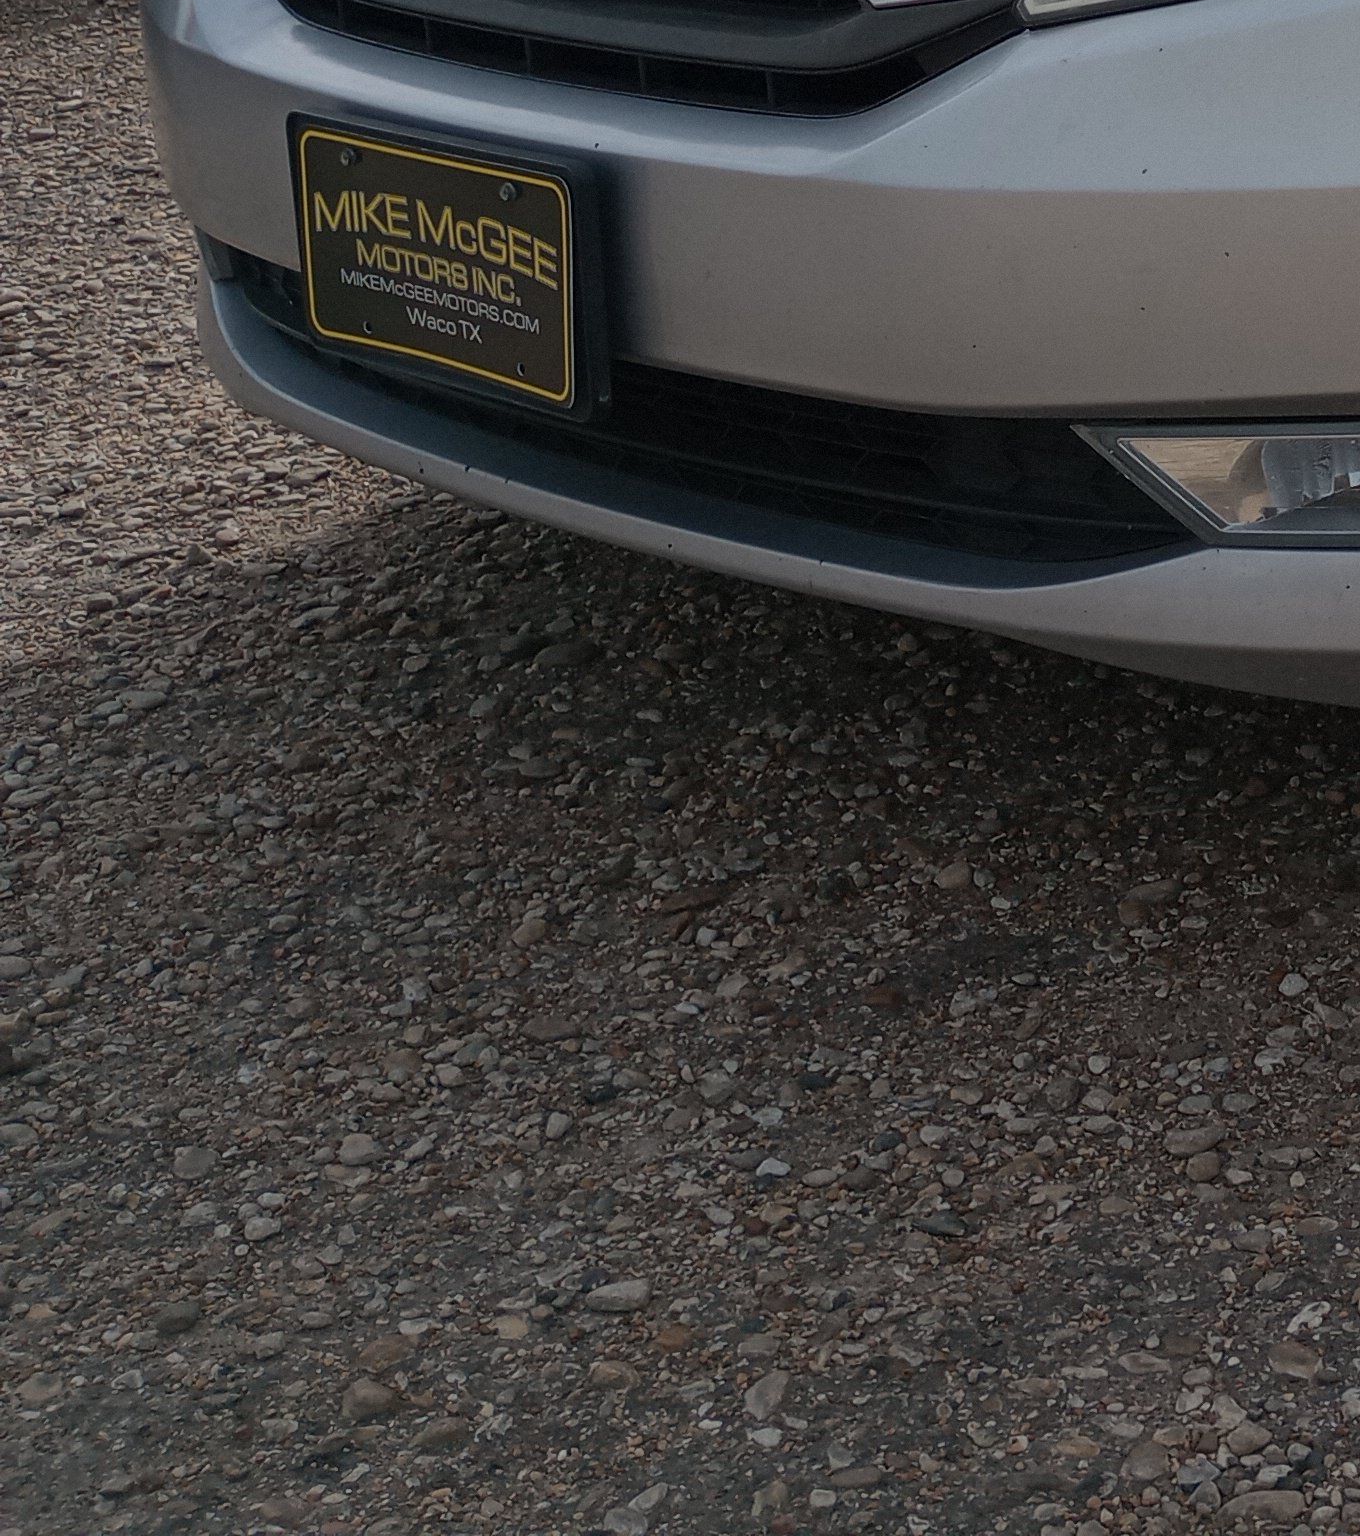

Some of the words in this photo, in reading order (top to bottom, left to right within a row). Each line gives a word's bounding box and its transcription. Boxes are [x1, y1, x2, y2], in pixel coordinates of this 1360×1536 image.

[313, 190, 412, 240] MIKE
[416, 199, 558, 291] McGEE
[356, 238, 469, 291] MOTORS
[472, 265, 522, 307] INC.
[340, 267, 541, 335] MIKEMcGEEMOTORS.COM
[406, 305, 457, 336] Waco
[458, 320, 483, 345] TX
